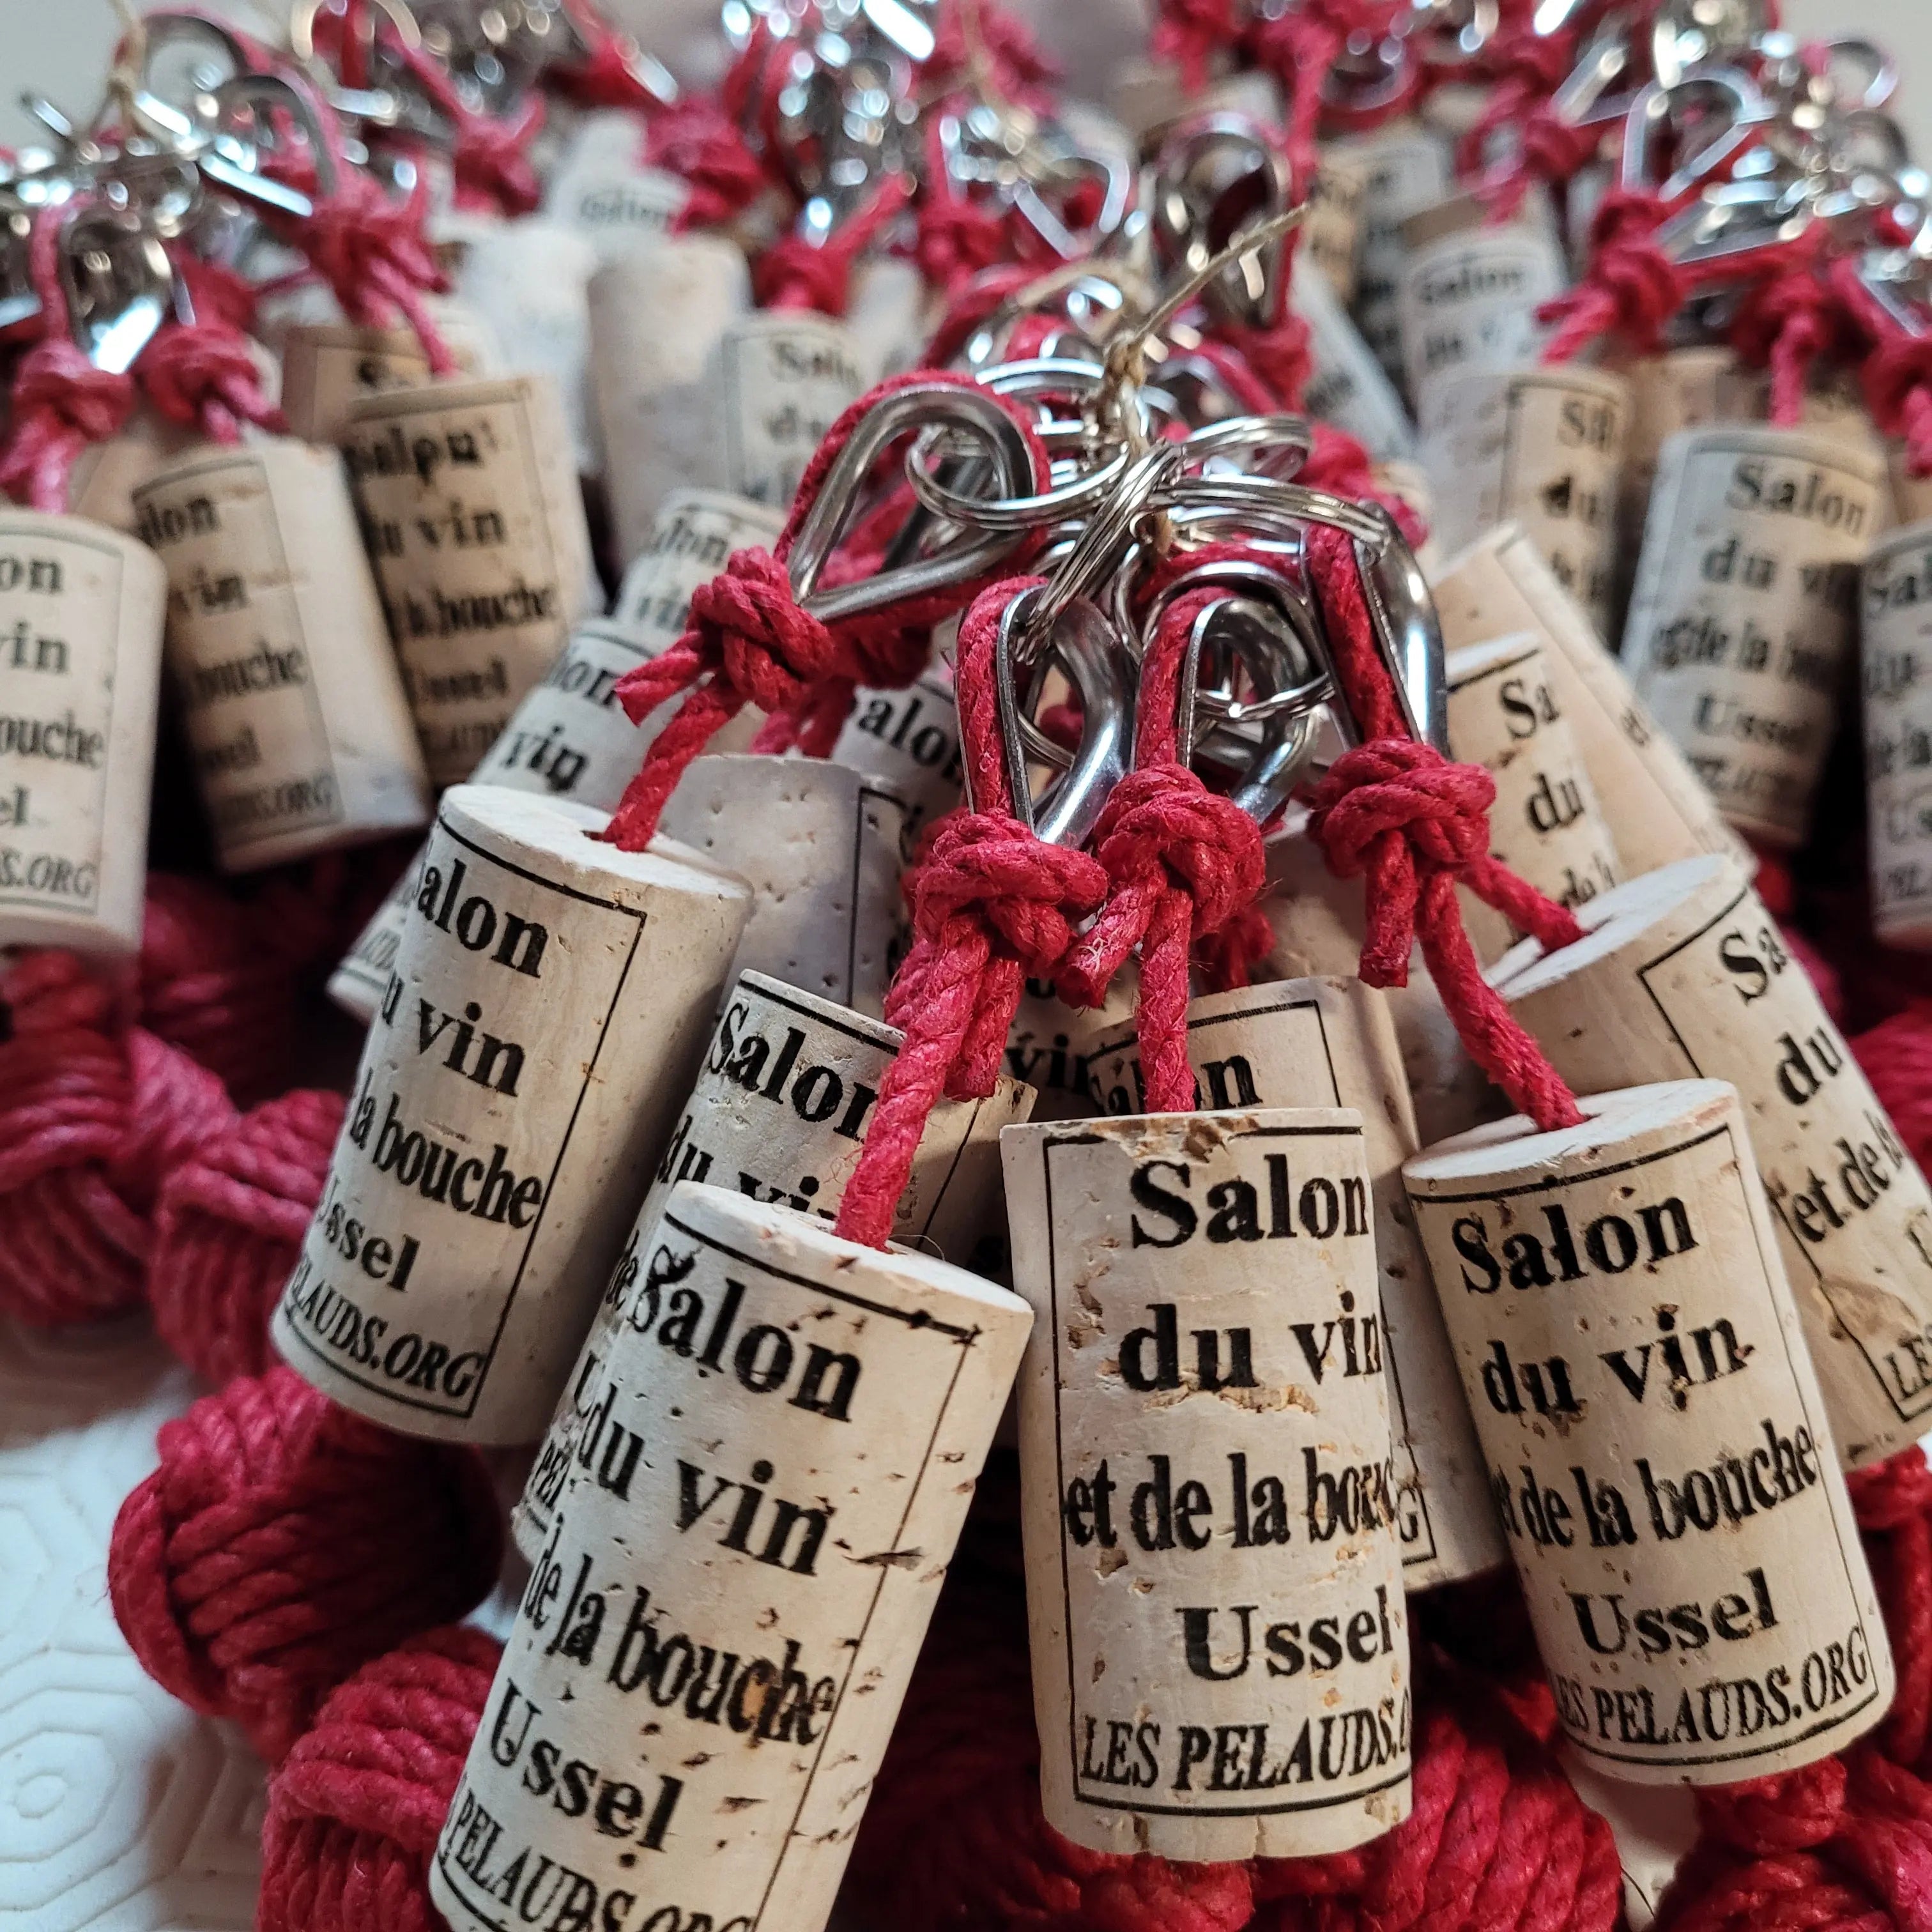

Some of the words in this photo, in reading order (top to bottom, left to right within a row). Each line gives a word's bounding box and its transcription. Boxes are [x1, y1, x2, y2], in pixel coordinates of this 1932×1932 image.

[0, 621, 70, 675] in
[0, 708, 103, 770] ouche
[856, 698, 960, 779] alo
[1526, 772, 1586, 832] du
[417, 857, 548, 980] alon
[417, 1000, 526, 1099] vin
[1775, 1024, 1843, 1107] du
[371, 1092, 546, 1230] bouche
[1130, 1153, 1370, 1250] Salon
[1791, 1166, 1846, 1244] et
[1834, 1135, 1891, 1211] de
[1449, 1193, 1699, 1295] Salon
[615, 1243, 862, 1425] Salon
[1117, 1303, 1257, 1394] du
[1288, 1291, 1383, 1386] vin
[1480, 1340, 1584, 1414] du
[1598, 1303, 1752, 1409] vin
[575, 1381, 647, 1504] du
[673, 1458, 836, 1578] vin
[1066, 1459, 1118, 1548] et
[1130, 1453, 1214, 1552] de
[1230, 1452, 1291, 1549] la
[1518, 1463, 1574, 1549] de
[1567, 1466, 1634, 1550] la
[1634, 1417, 1818, 1541] bouche
[544, 1551, 606, 1669] la
[606, 1584, 837, 1748] bouche
[1173, 1584, 1393, 1683] Ussel
[1564, 1565, 1782, 1656] Ussel
[1595, 1623, 1868, 1747] PELAUDS.ORG
[489, 1676, 685, 1854] Ussel
[1080, 1712, 1160, 1787] LES
